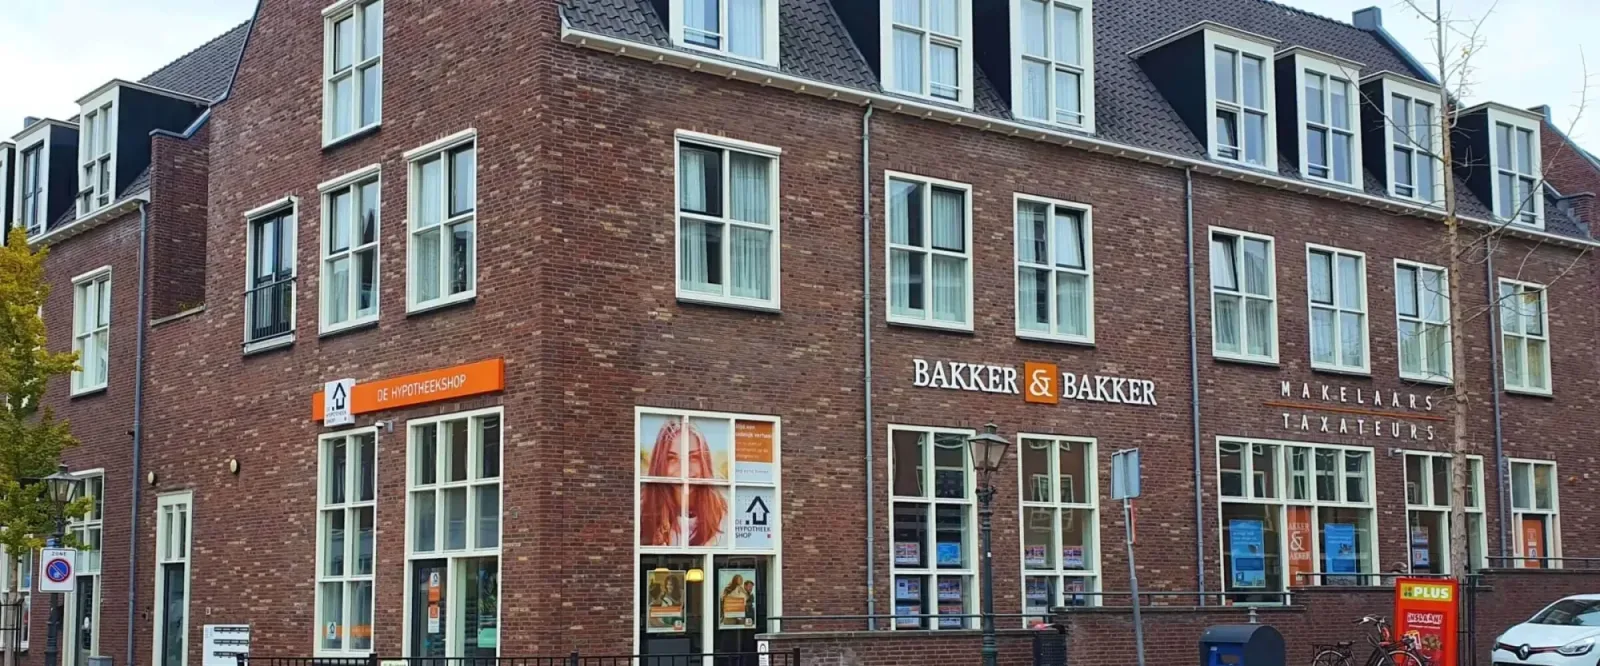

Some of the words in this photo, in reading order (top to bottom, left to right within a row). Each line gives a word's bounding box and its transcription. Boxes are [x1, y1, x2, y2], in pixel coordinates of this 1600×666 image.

[377, 386, 389, 402] DE
[391, 374, 467, 398] HYPOTHEEKSHOP
[913, 359, 1020, 394] BAKKER
[1029, 369, 1053, 397] &
[1062, 372, 1158, 406] BAKKER
[1281, 381, 1432, 411] MAKELAARS
[1283, 413, 1434, 440] TAXATEURS
[1288, 522, 1310, 532] AKKER
[1290, 531, 1305, 551] &
[1413, 586, 1450, 599] PLUS
